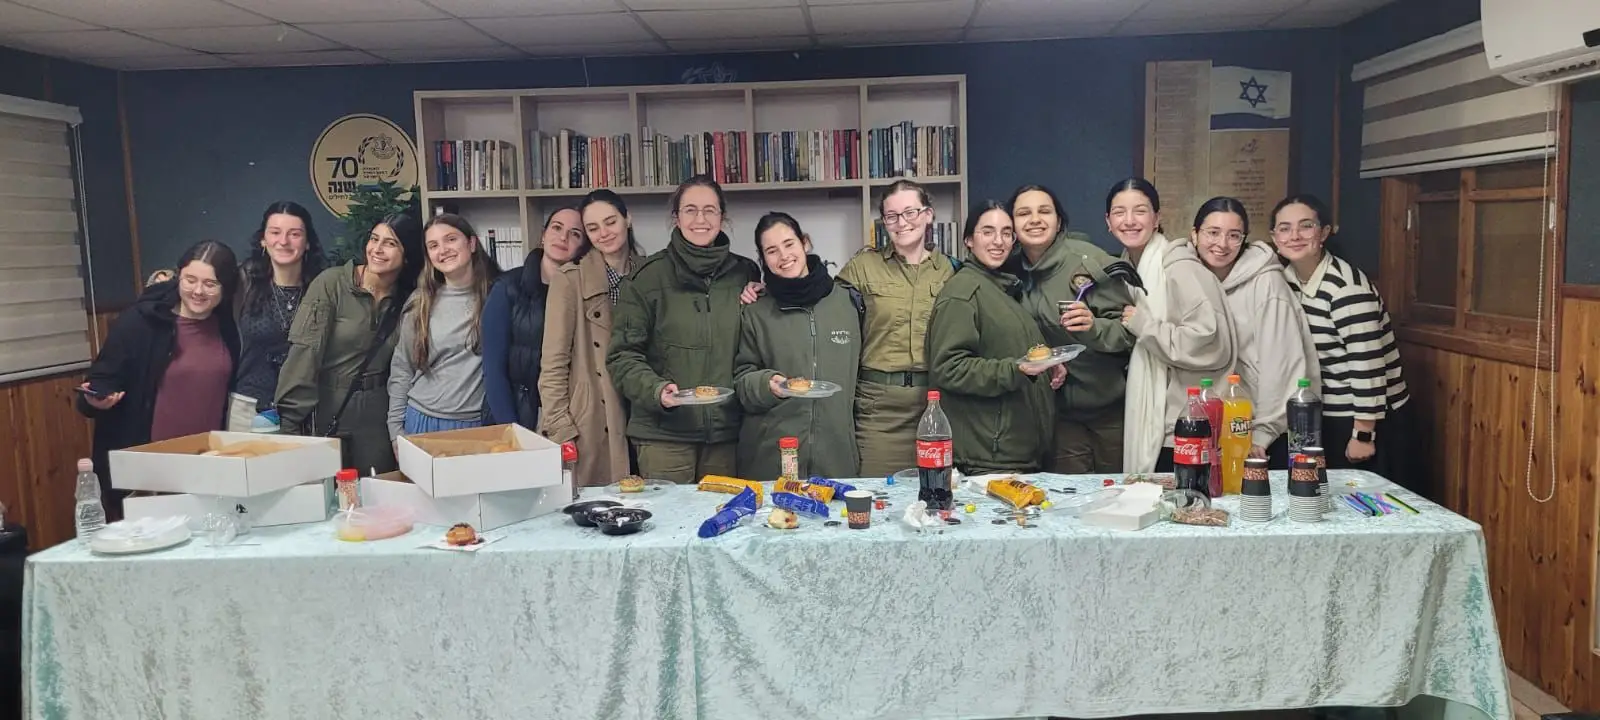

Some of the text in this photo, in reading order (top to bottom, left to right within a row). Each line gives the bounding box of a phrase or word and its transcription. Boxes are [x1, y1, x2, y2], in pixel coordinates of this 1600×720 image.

[326, 156, 359, 179] 70
[328, 181, 356, 193] שנה
[1230, 420, 1251, 432] FANT
